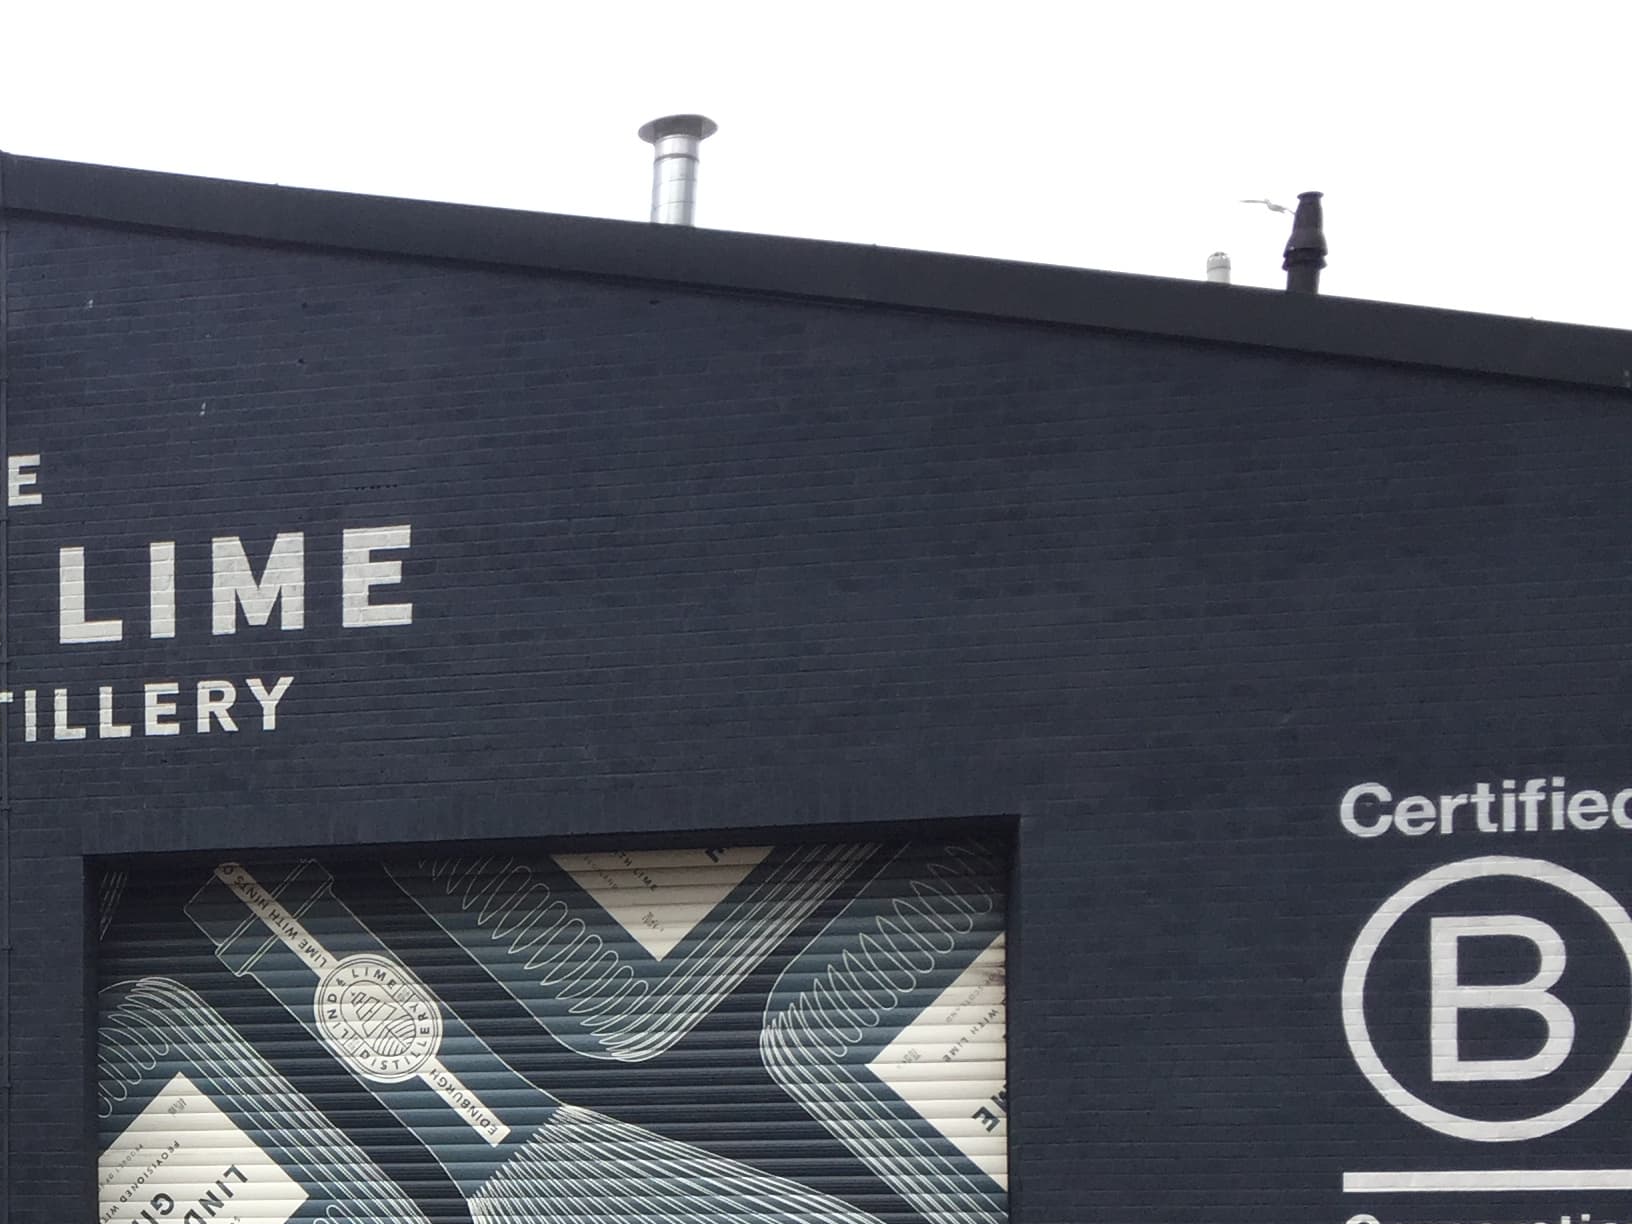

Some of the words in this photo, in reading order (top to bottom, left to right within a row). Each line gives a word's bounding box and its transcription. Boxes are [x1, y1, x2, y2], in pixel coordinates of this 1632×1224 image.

[59, 523, 414, 645] LIME
[271, 907, 299, 940] WITH
[297, 937, 329, 969] LIME
[351, 966, 397, 991] LIME
[1430, 914, 1575, 1082] B
[429, 1067, 499, 1137] EDINBURGH
